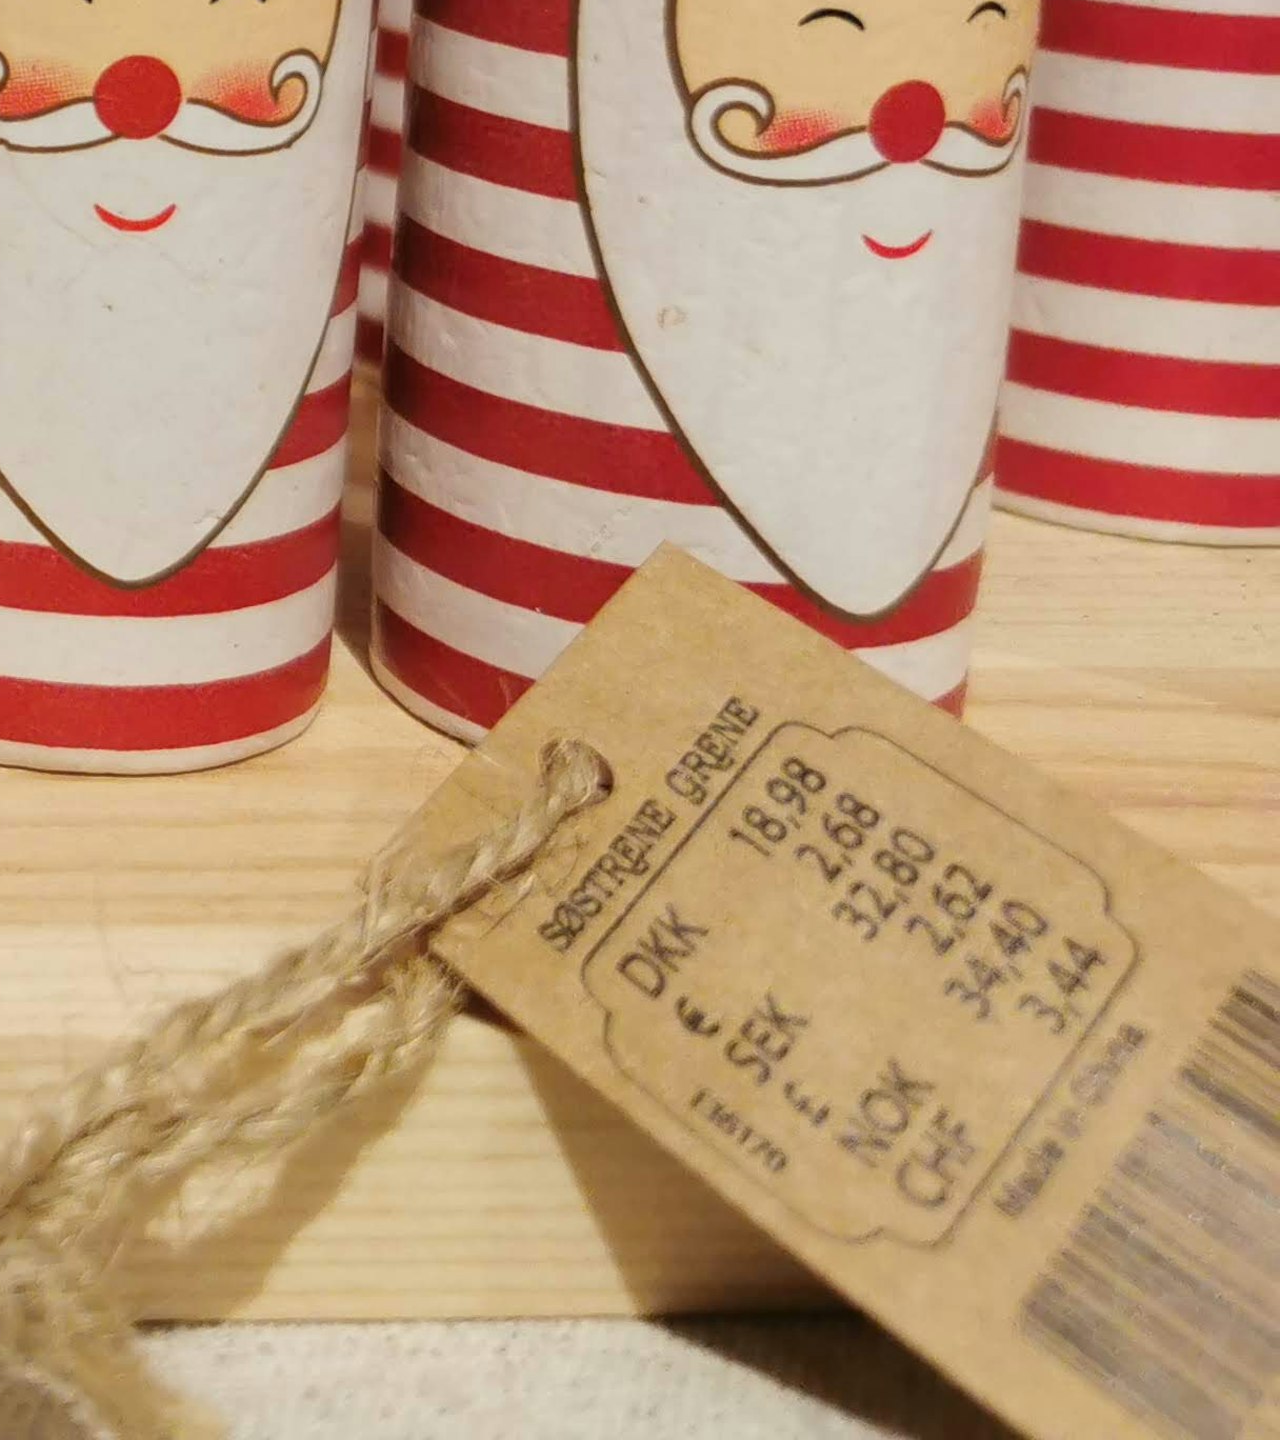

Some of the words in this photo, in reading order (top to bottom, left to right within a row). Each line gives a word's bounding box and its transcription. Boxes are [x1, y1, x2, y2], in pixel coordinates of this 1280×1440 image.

[537, 799, 678, 955] SØSTRENE
[665, 696, 760, 807] GRENE
[615, 907, 710, 1000] DKK
[728, 756, 827, 857] 18,98
[793, 792, 881, 884] 2,68
[903, 862, 994, 957] 2,62
[723, 994, 808, 1084] SEK
[834, 826, 937, 942] 32,80
[836, 1059, 936, 1169] NOK
[944, 899, 1050, 1020] 34,40
[894, 1105, 976, 1211] CHF
[1018, 936, 1107, 1035] 3,44
